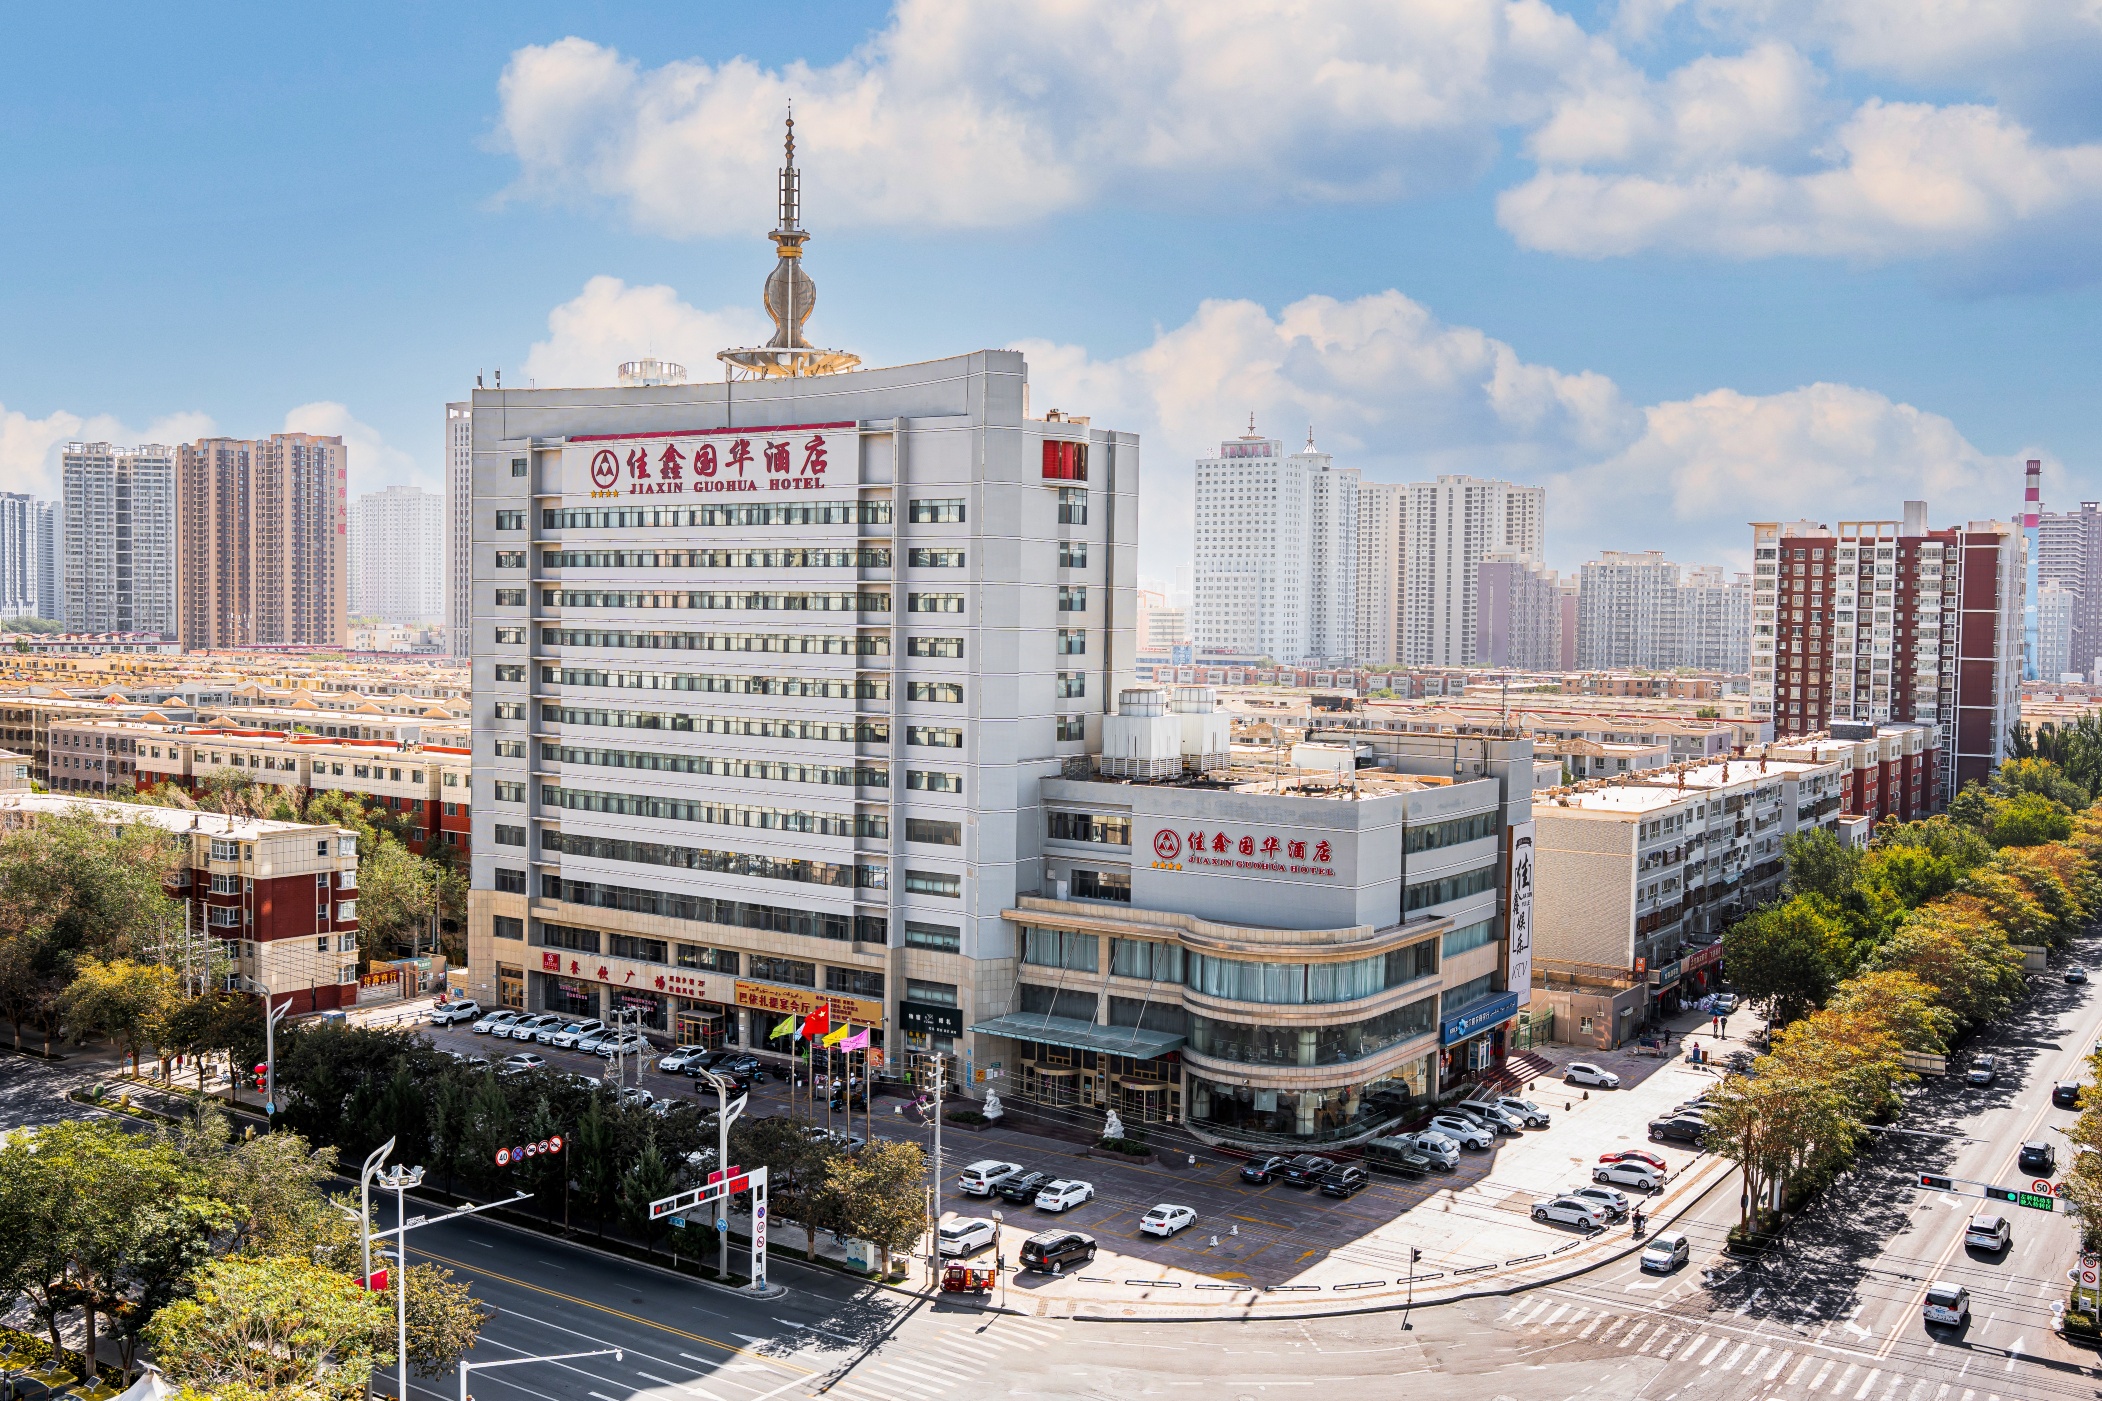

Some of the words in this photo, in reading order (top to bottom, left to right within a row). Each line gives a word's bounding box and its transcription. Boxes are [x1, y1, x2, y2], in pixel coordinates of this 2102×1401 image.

[626, 434, 828, 480] 佳鑫国华酒店
[629, 481, 683, 495] JIAXIN
[693, 479, 758, 493] GUOHUA
[769, 477, 825, 491] HOTEL
[337, 468, 347, 535] 顶秀大厦
[1187, 830, 1333, 863] 佳鑫国华酒店
[1188, 855, 1234, 867] JIAXIN
[1235, 860, 1287, 872] GUOHUA
[1290, 866, 1336, 877] HOTEL
[570, 959, 666, 990] 餐饮广场
[499, 1152, 508, 1161] 40
[2036, 1183, 2048, 1193] 50
